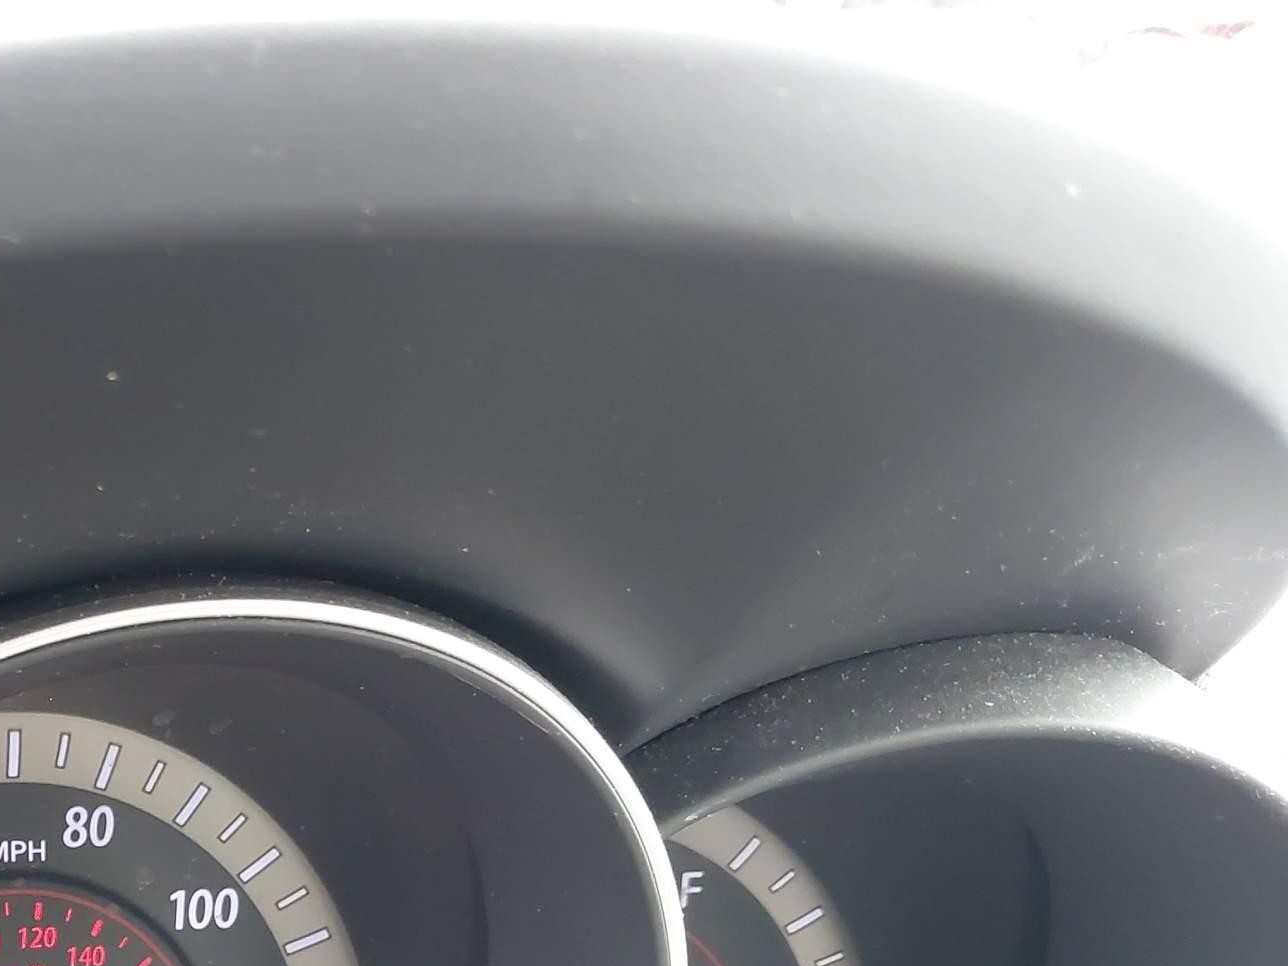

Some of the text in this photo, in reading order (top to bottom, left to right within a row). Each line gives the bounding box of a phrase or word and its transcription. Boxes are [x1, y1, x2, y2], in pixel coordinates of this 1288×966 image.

[62, 805, 113, 848] 80
[170, 888, 238, 931] 100
[18, 926, 57, 950] 120
